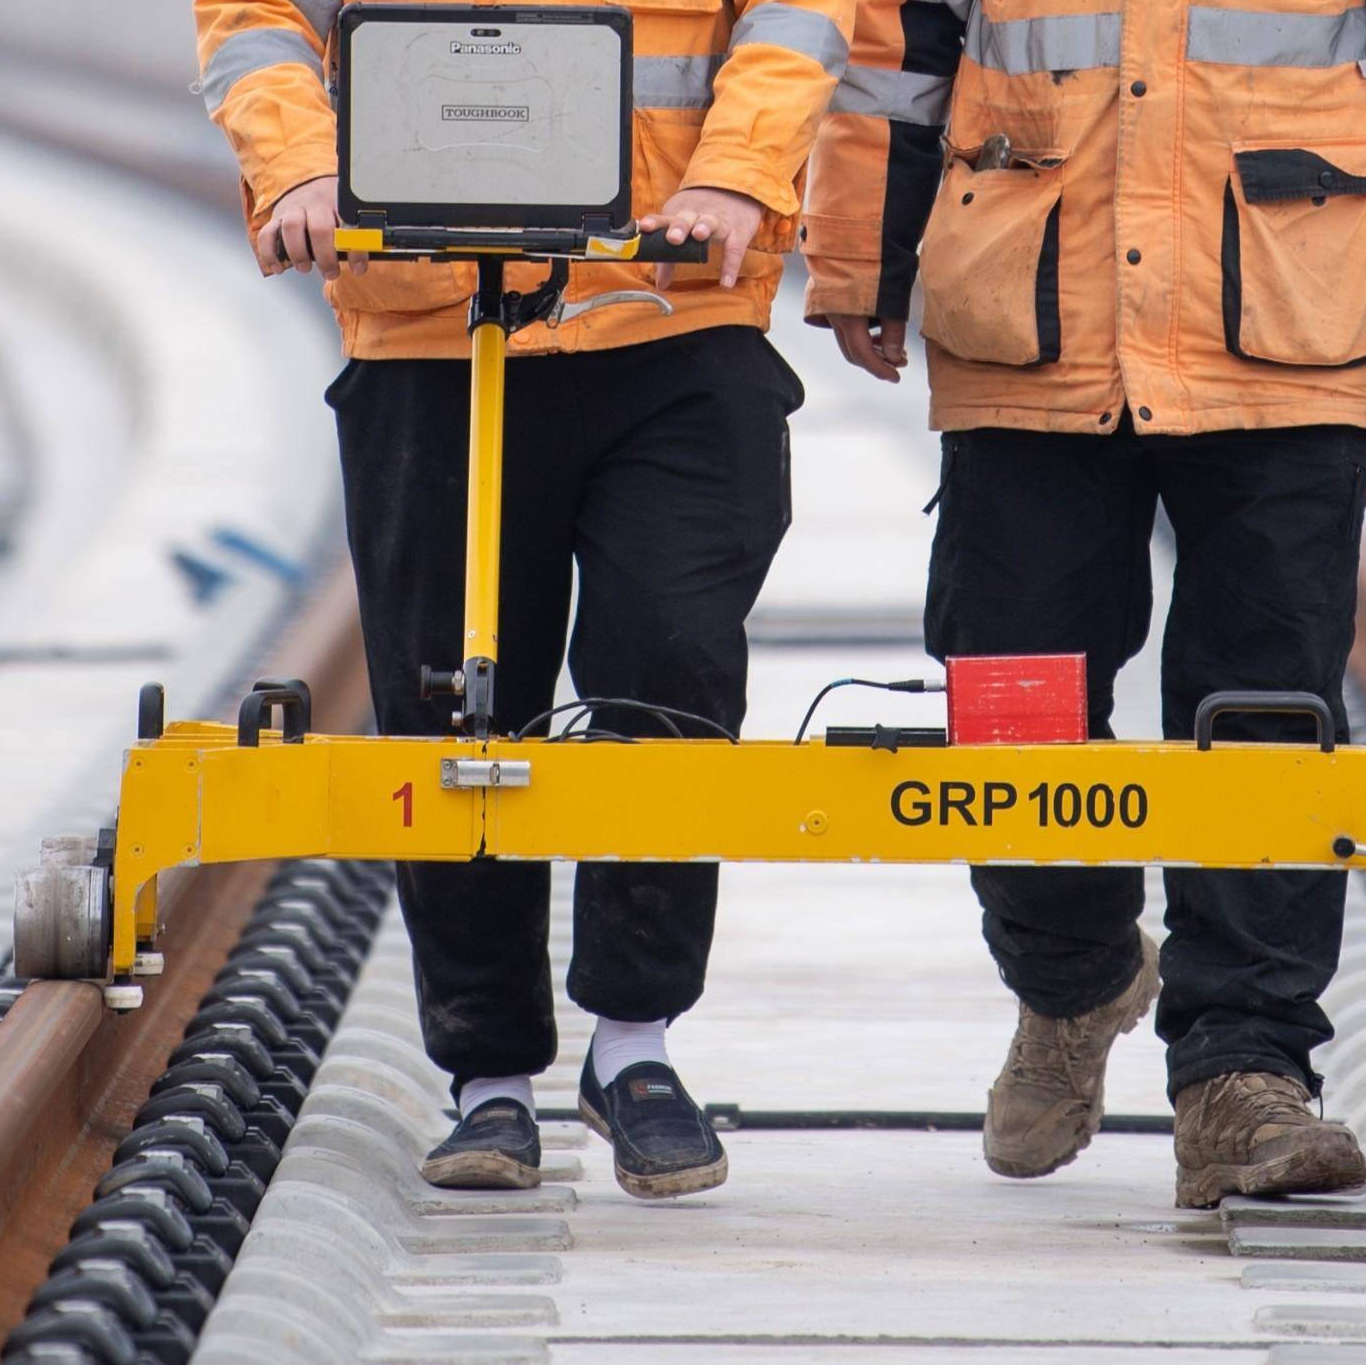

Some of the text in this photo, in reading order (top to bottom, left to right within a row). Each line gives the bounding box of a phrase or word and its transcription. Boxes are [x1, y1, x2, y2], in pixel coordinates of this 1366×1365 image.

[450, 41, 522, 55] Panasonic
[446, 108, 526, 119] TOUGHBOOK
[392, 782, 413, 827] 1
[890, 780, 1148, 828] GRP 1000
